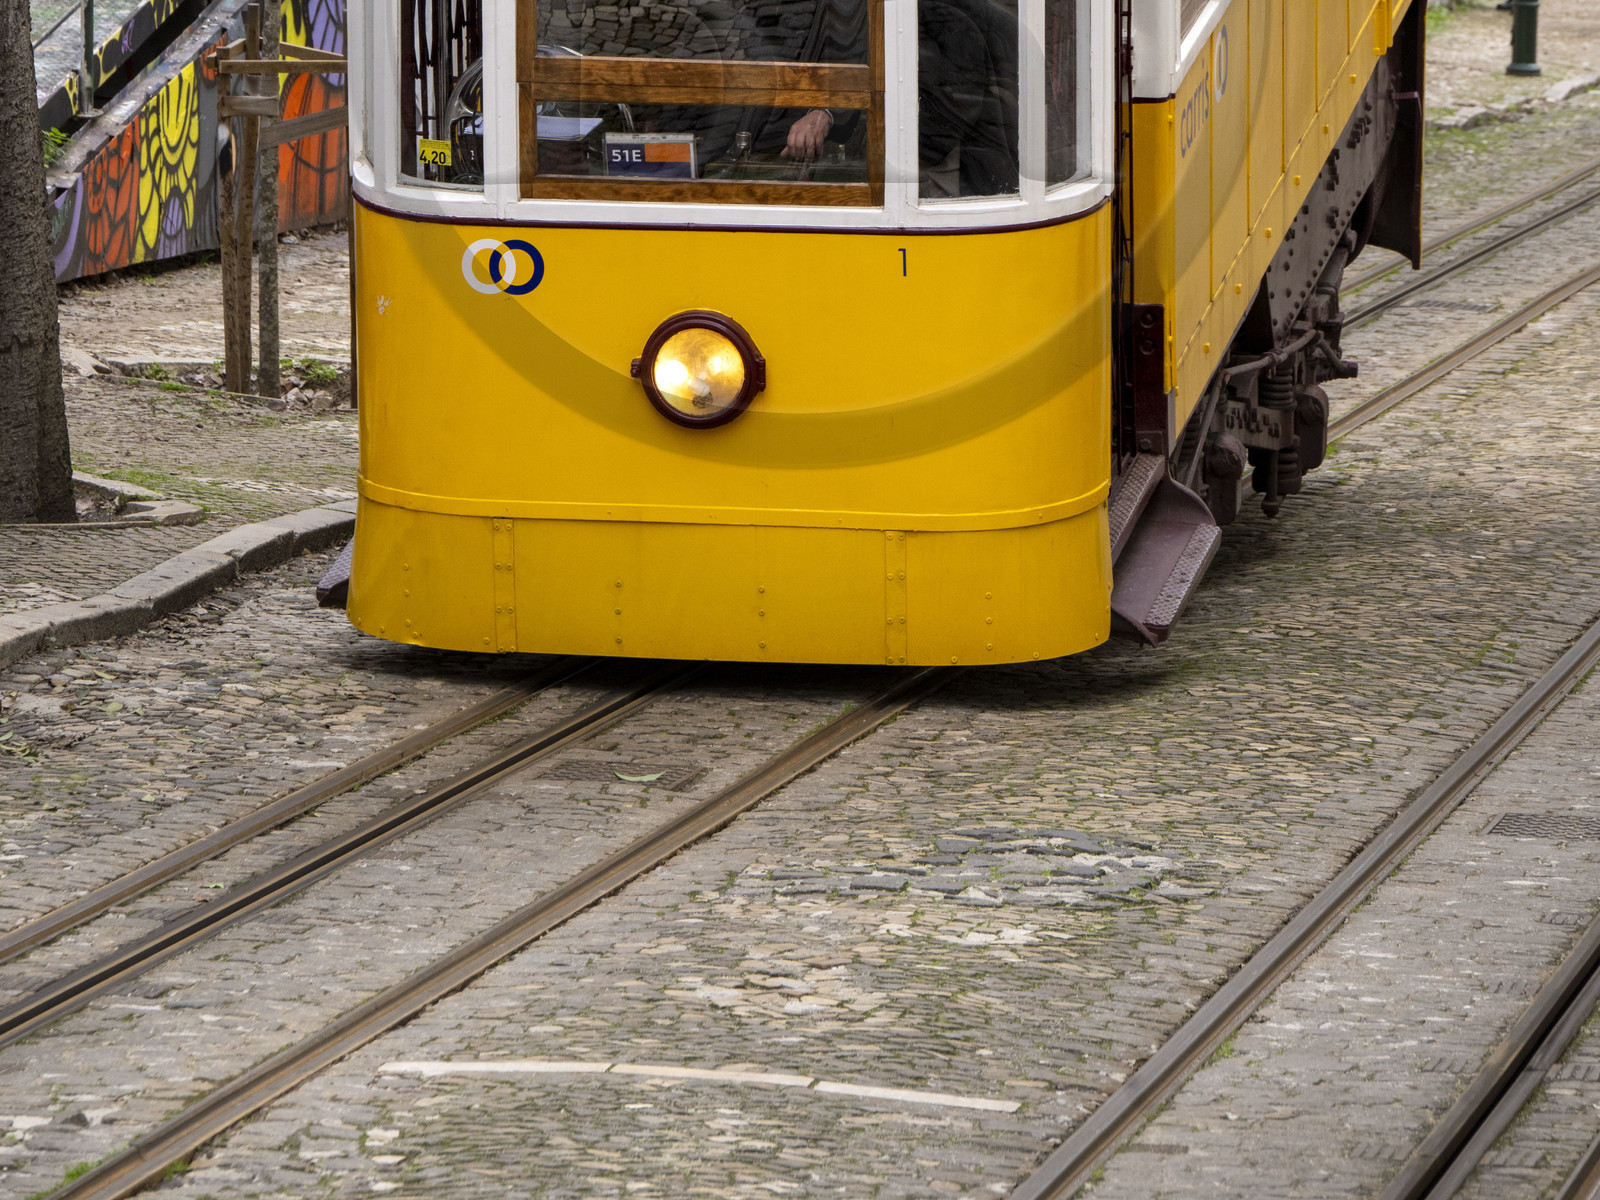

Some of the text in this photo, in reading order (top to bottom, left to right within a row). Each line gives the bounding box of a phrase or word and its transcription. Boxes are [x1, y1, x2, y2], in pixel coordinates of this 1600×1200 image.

[1180, 57, 1210, 158] carris
[419, 150, 446, 165] 4,20
[612, 149, 642, 163] 51E
[898, 248, 908, 277] 1
